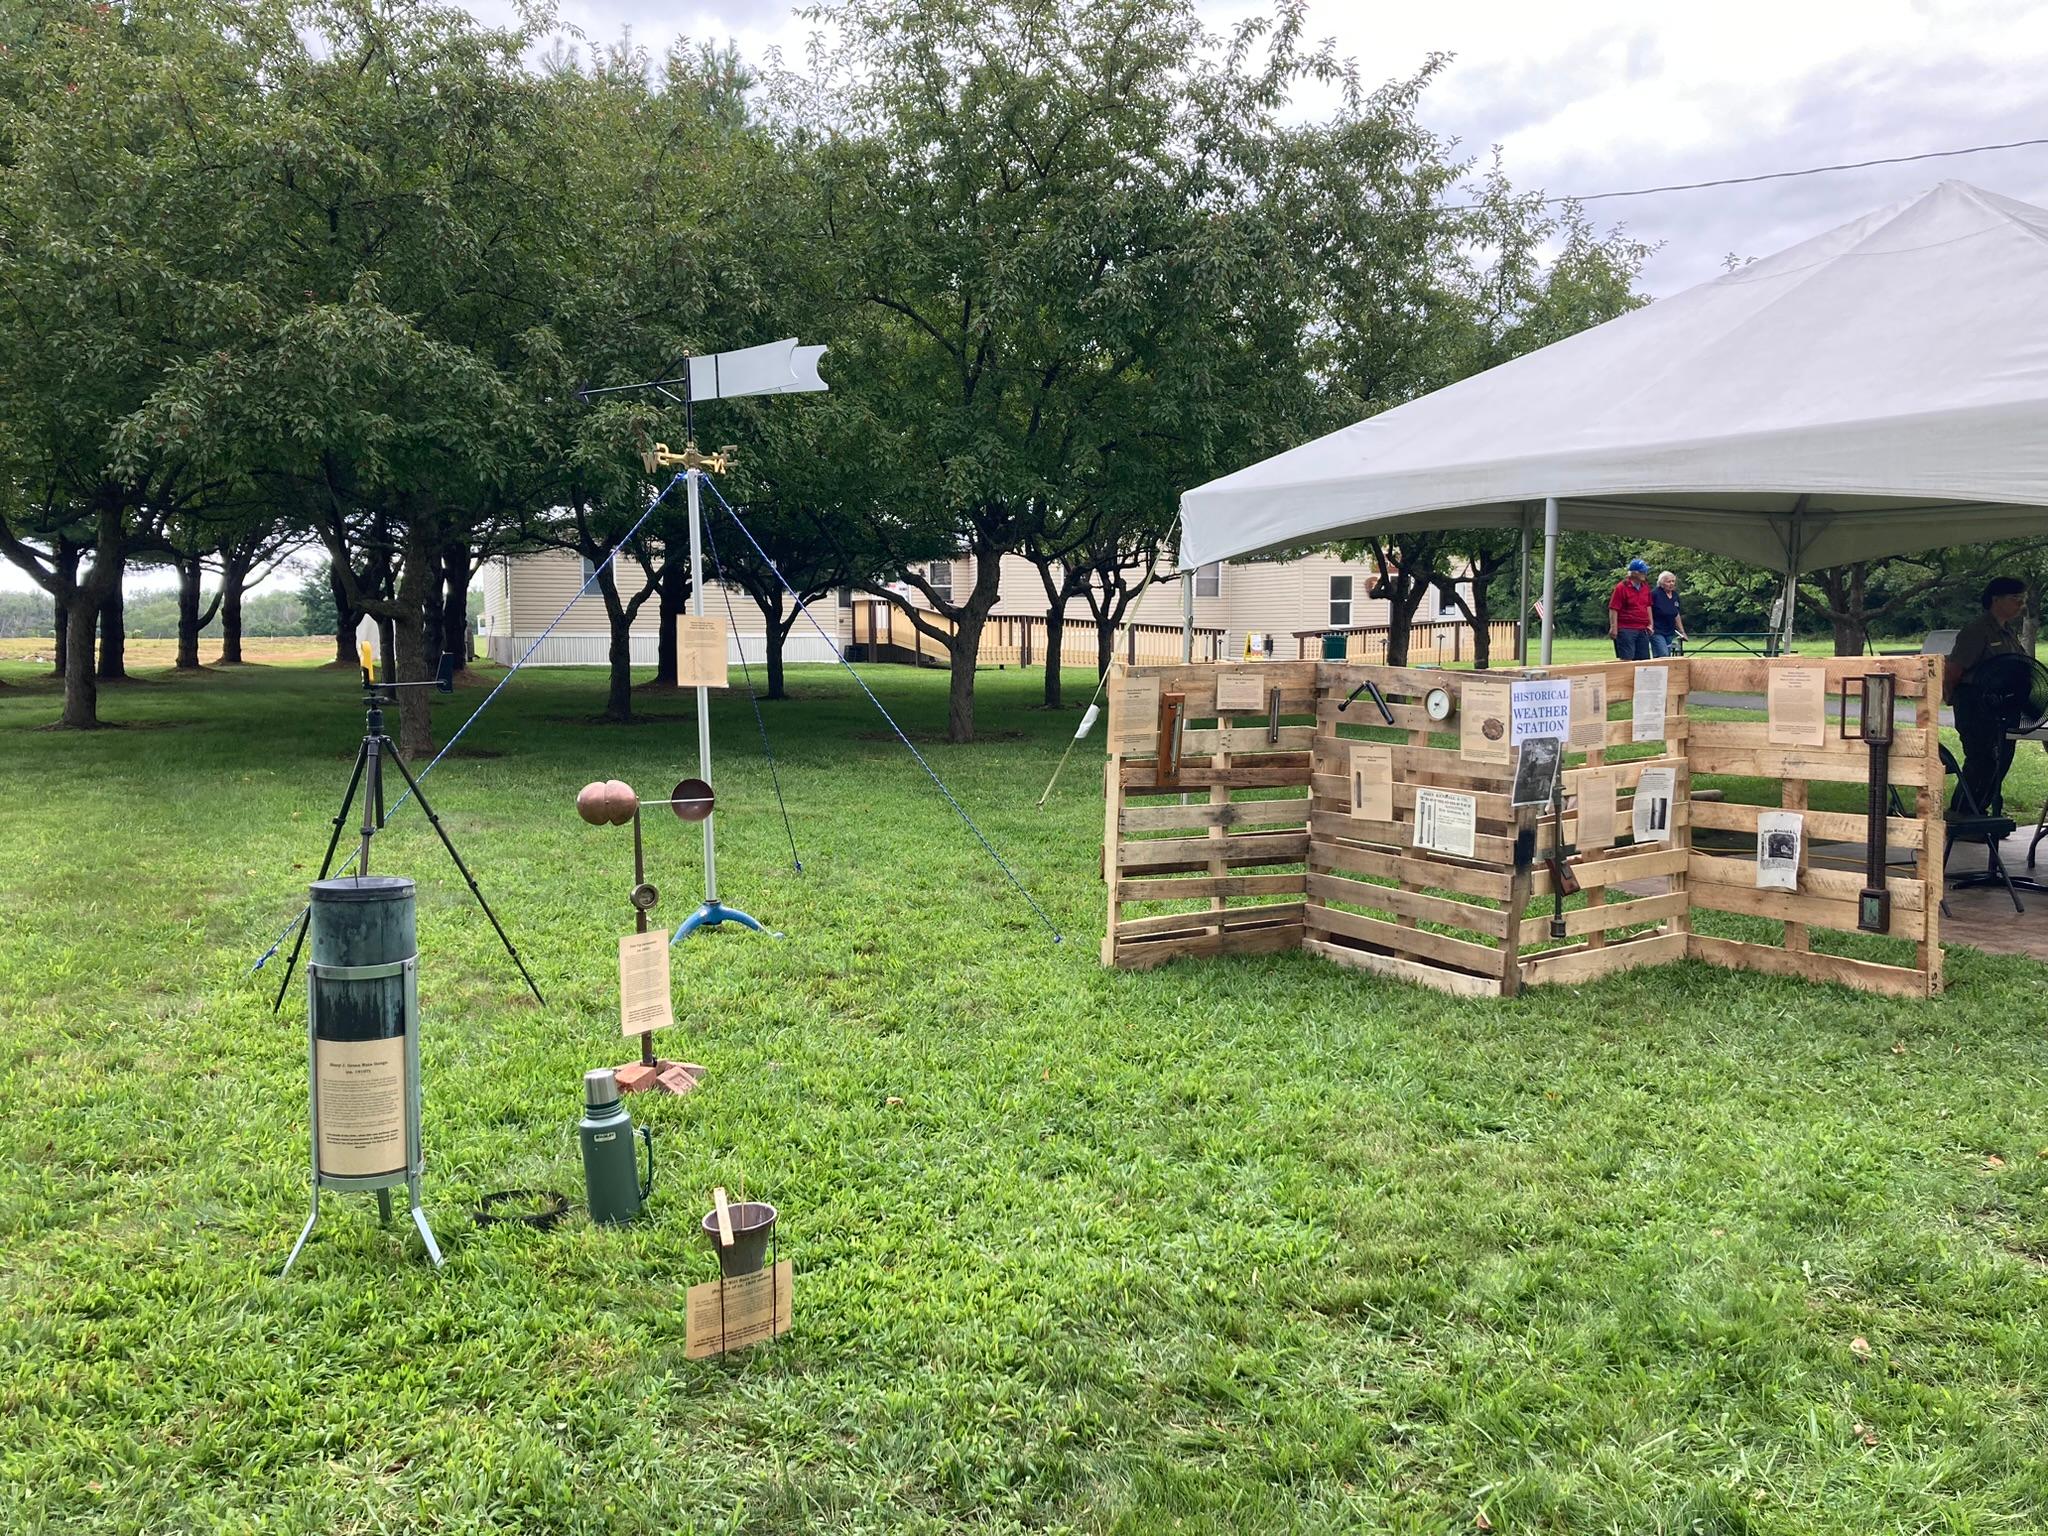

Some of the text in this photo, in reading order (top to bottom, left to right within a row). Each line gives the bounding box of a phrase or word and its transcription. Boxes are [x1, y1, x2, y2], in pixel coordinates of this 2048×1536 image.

[1513, 690, 1569, 702] HISTORICAL
[1513, 705, 1568, 719] WEATHER
[1516, 720, 1564, 734] STATION
